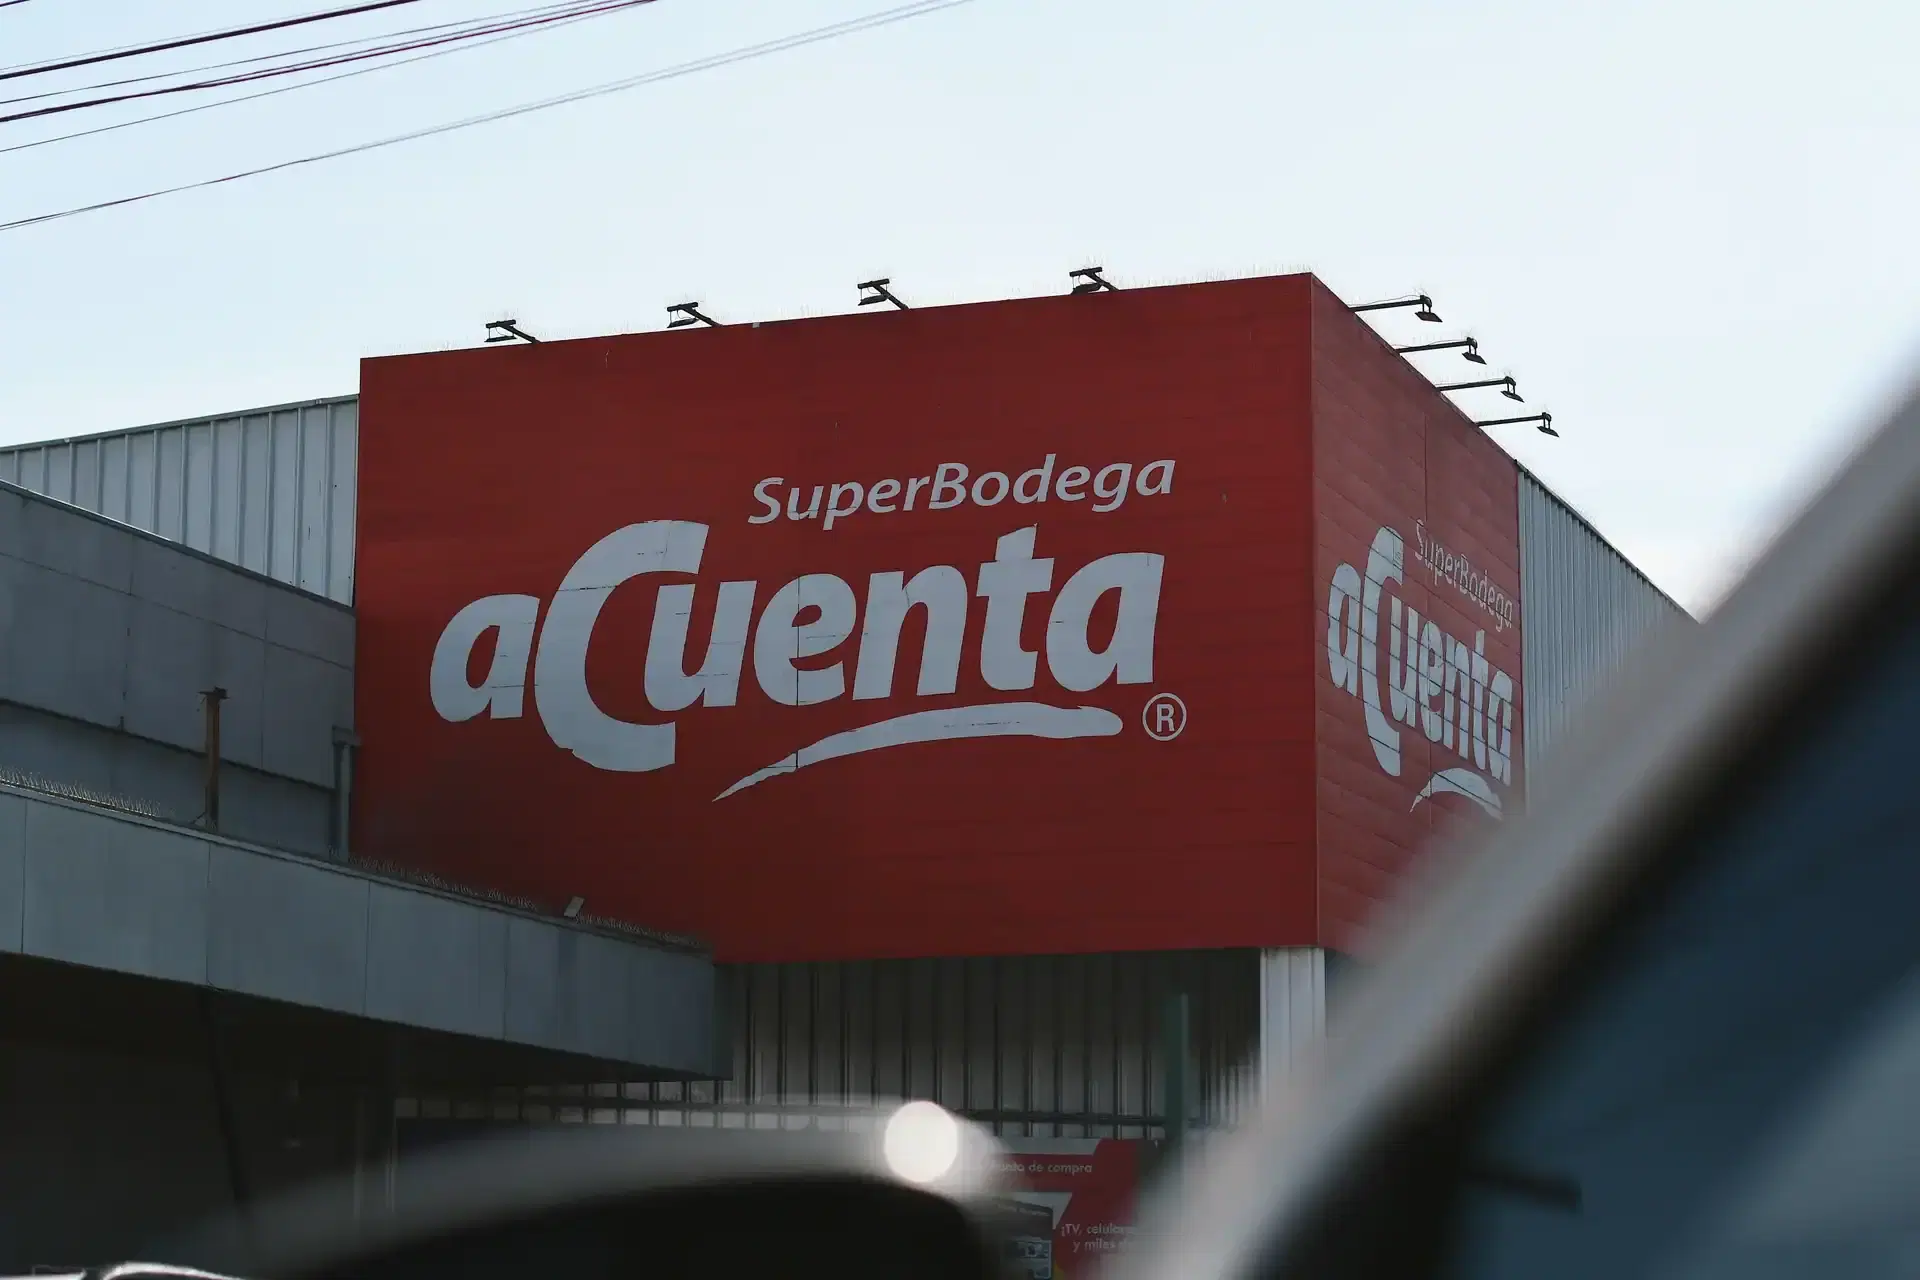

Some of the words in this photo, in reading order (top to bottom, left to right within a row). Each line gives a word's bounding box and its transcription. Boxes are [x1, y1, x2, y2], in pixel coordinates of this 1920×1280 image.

[749, 453, 1176, 530] SuperBodega
[1413, 519, 1513, 632] SuperBodega
[429, 519, 1165, 772] aCuenta
[1328, 525, 1512, 786] aCuenta
[1028, 1160, 1044, 1172] de
[1047, 1163, 1093, 1176] compra
[1072, 1241, 1081, 1254] y
